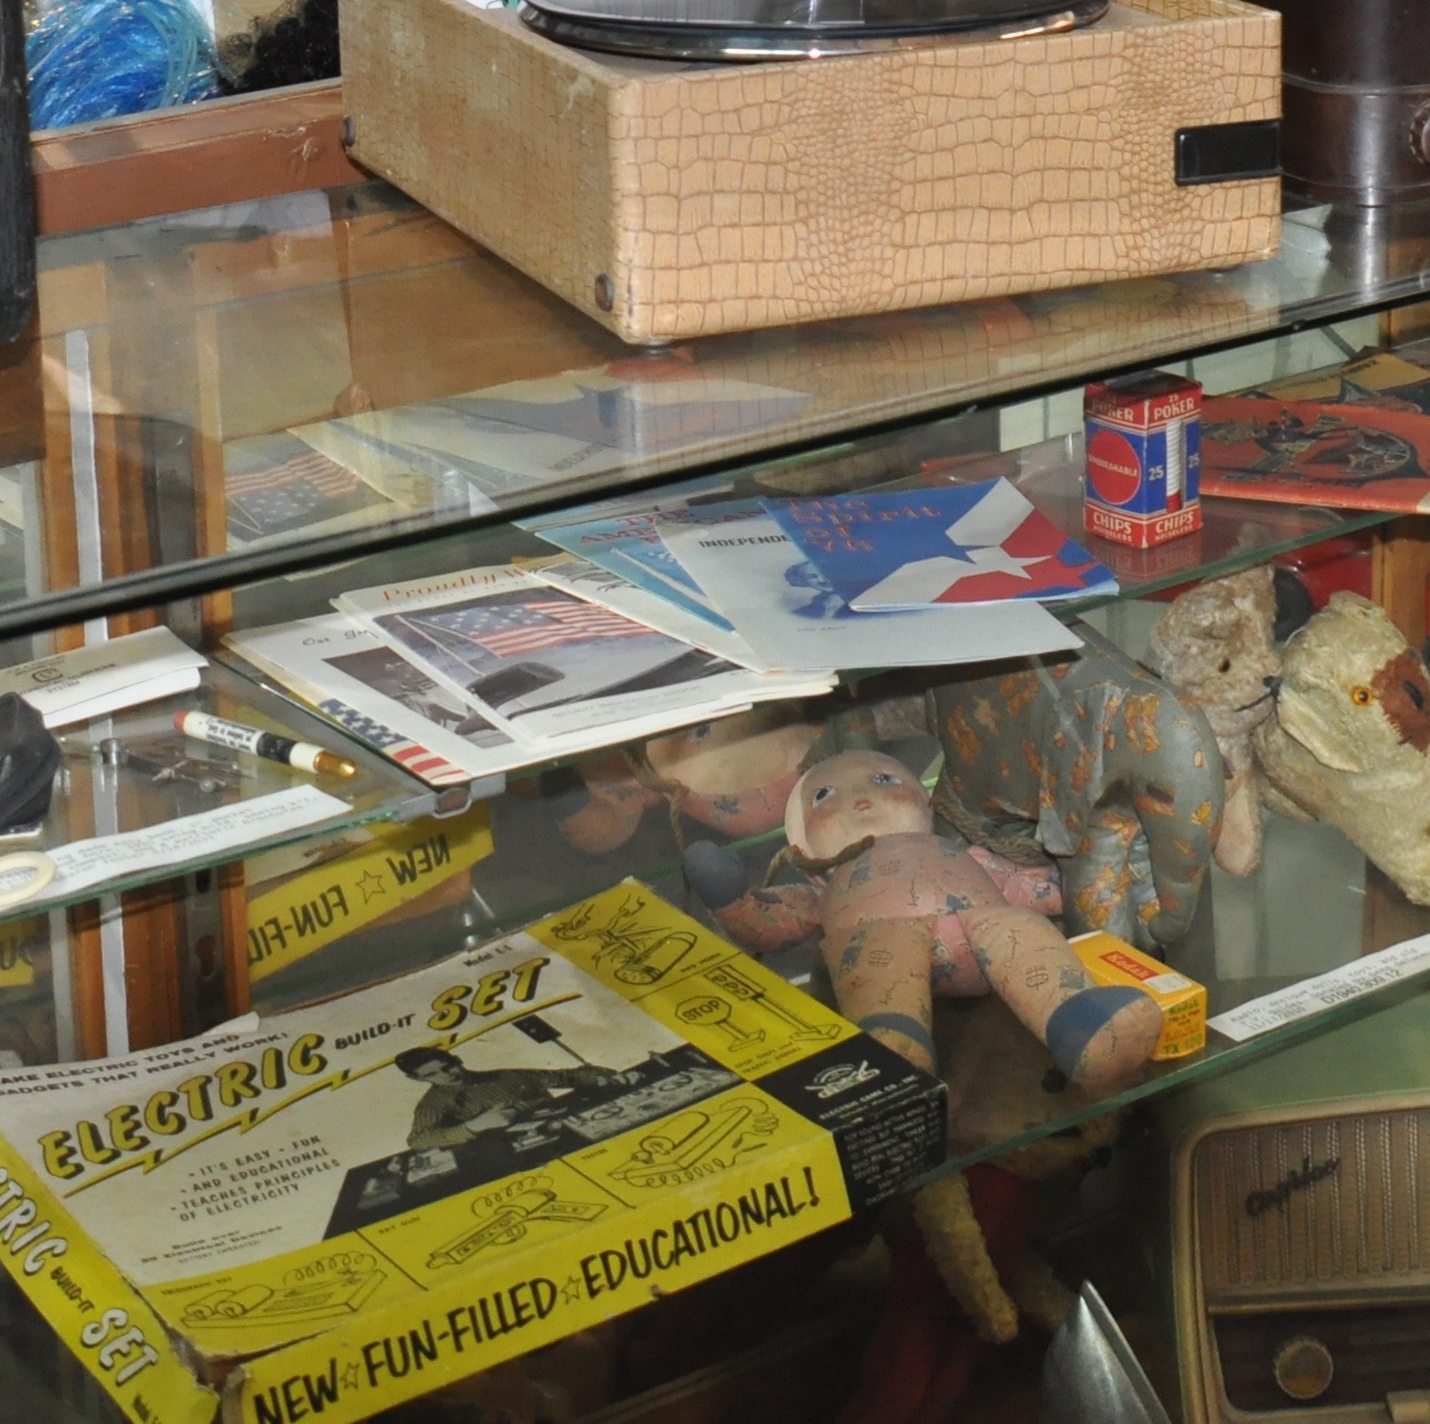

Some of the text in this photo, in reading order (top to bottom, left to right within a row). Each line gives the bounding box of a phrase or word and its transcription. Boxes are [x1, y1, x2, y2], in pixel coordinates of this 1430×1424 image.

[1154, 397, 1195, 420] POKER
[1088, 454, 1138, 477] UNBREAKABLE
[1148, 465, 1164, 481] 25
[1188, 453, 1199, 468] 25
[1093, 511, 1132, 534] CHIPS
[1155, 511, 1194, 534] CHIPS
[1108, 953, 1150, 977] Kodak
[681, 1000, 721, 1022] STOP
[38, 956, 551, 1180] ELECTRIC BUILD-IT SET
[45, 1058, 138, 1080] ELECTRIC
[143, 1041, 198, 1064] TOYS
[201, 1032, 241, 1051] AND
[93, 1070, 137, 1085] THAT
[145, 1050, 216, 1075] REALLY
[220, 1030, 290, 1058] WORK!
[192, 1147, 330, 1193] AND EDUCATIONAL
[199, 1135, 321, 1177] IT'S EASY FUN
[178, 1182, 301, 1223] OF ELECTRICITY
[180, 1158, 341, 1211] TEACHES PRINCIPLES
[251, 1165, 823, 1424] NEW FUN-FILLED EDUCATIONAL!
[50, 1266, 95, 1314] BUILD-IT
[80, 1307, 159, 1386] SET
